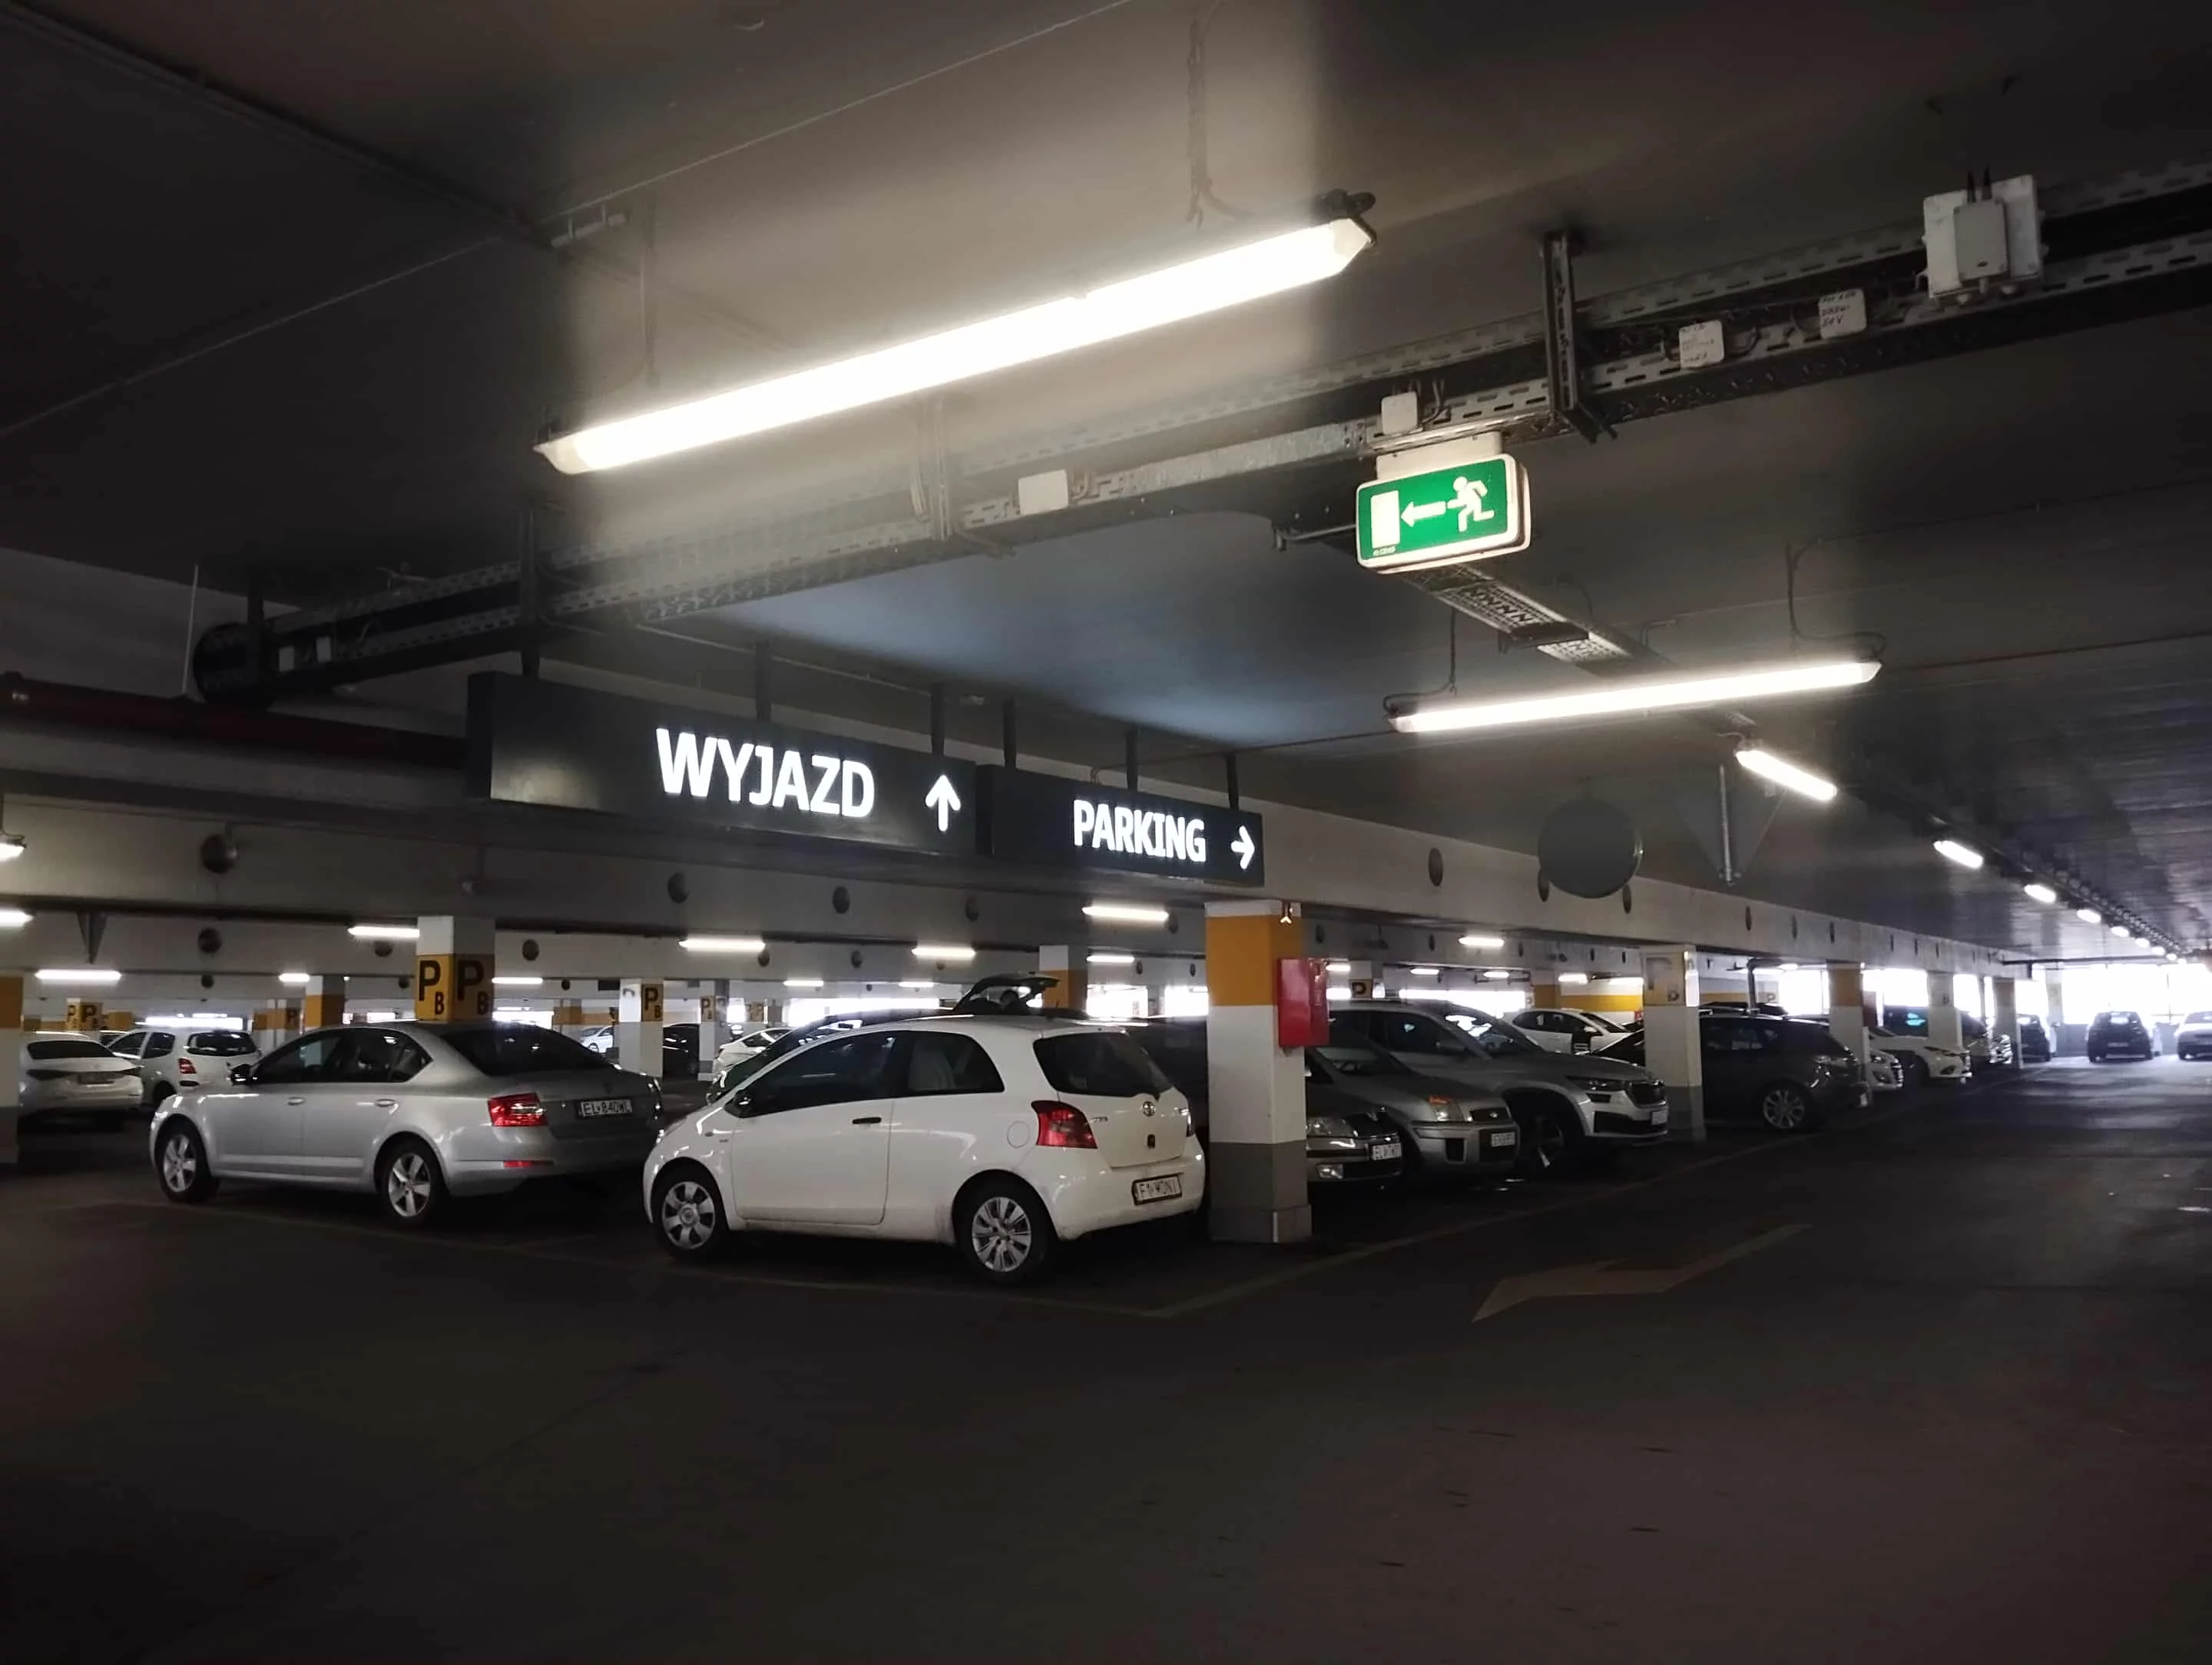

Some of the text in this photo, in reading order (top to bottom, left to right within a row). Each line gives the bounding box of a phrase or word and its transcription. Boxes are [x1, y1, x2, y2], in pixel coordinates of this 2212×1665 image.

[656, 728, 874, 818] WYJAZD
[1073, 799, 1206, 862] PARKING
[419, 960, 442, 1001] P
[458, 959, 485, 1001] P
[644, 987, 658, 1011] P
[435, 991, 444, 1015] B
[478, 991, 488, 1015] B
